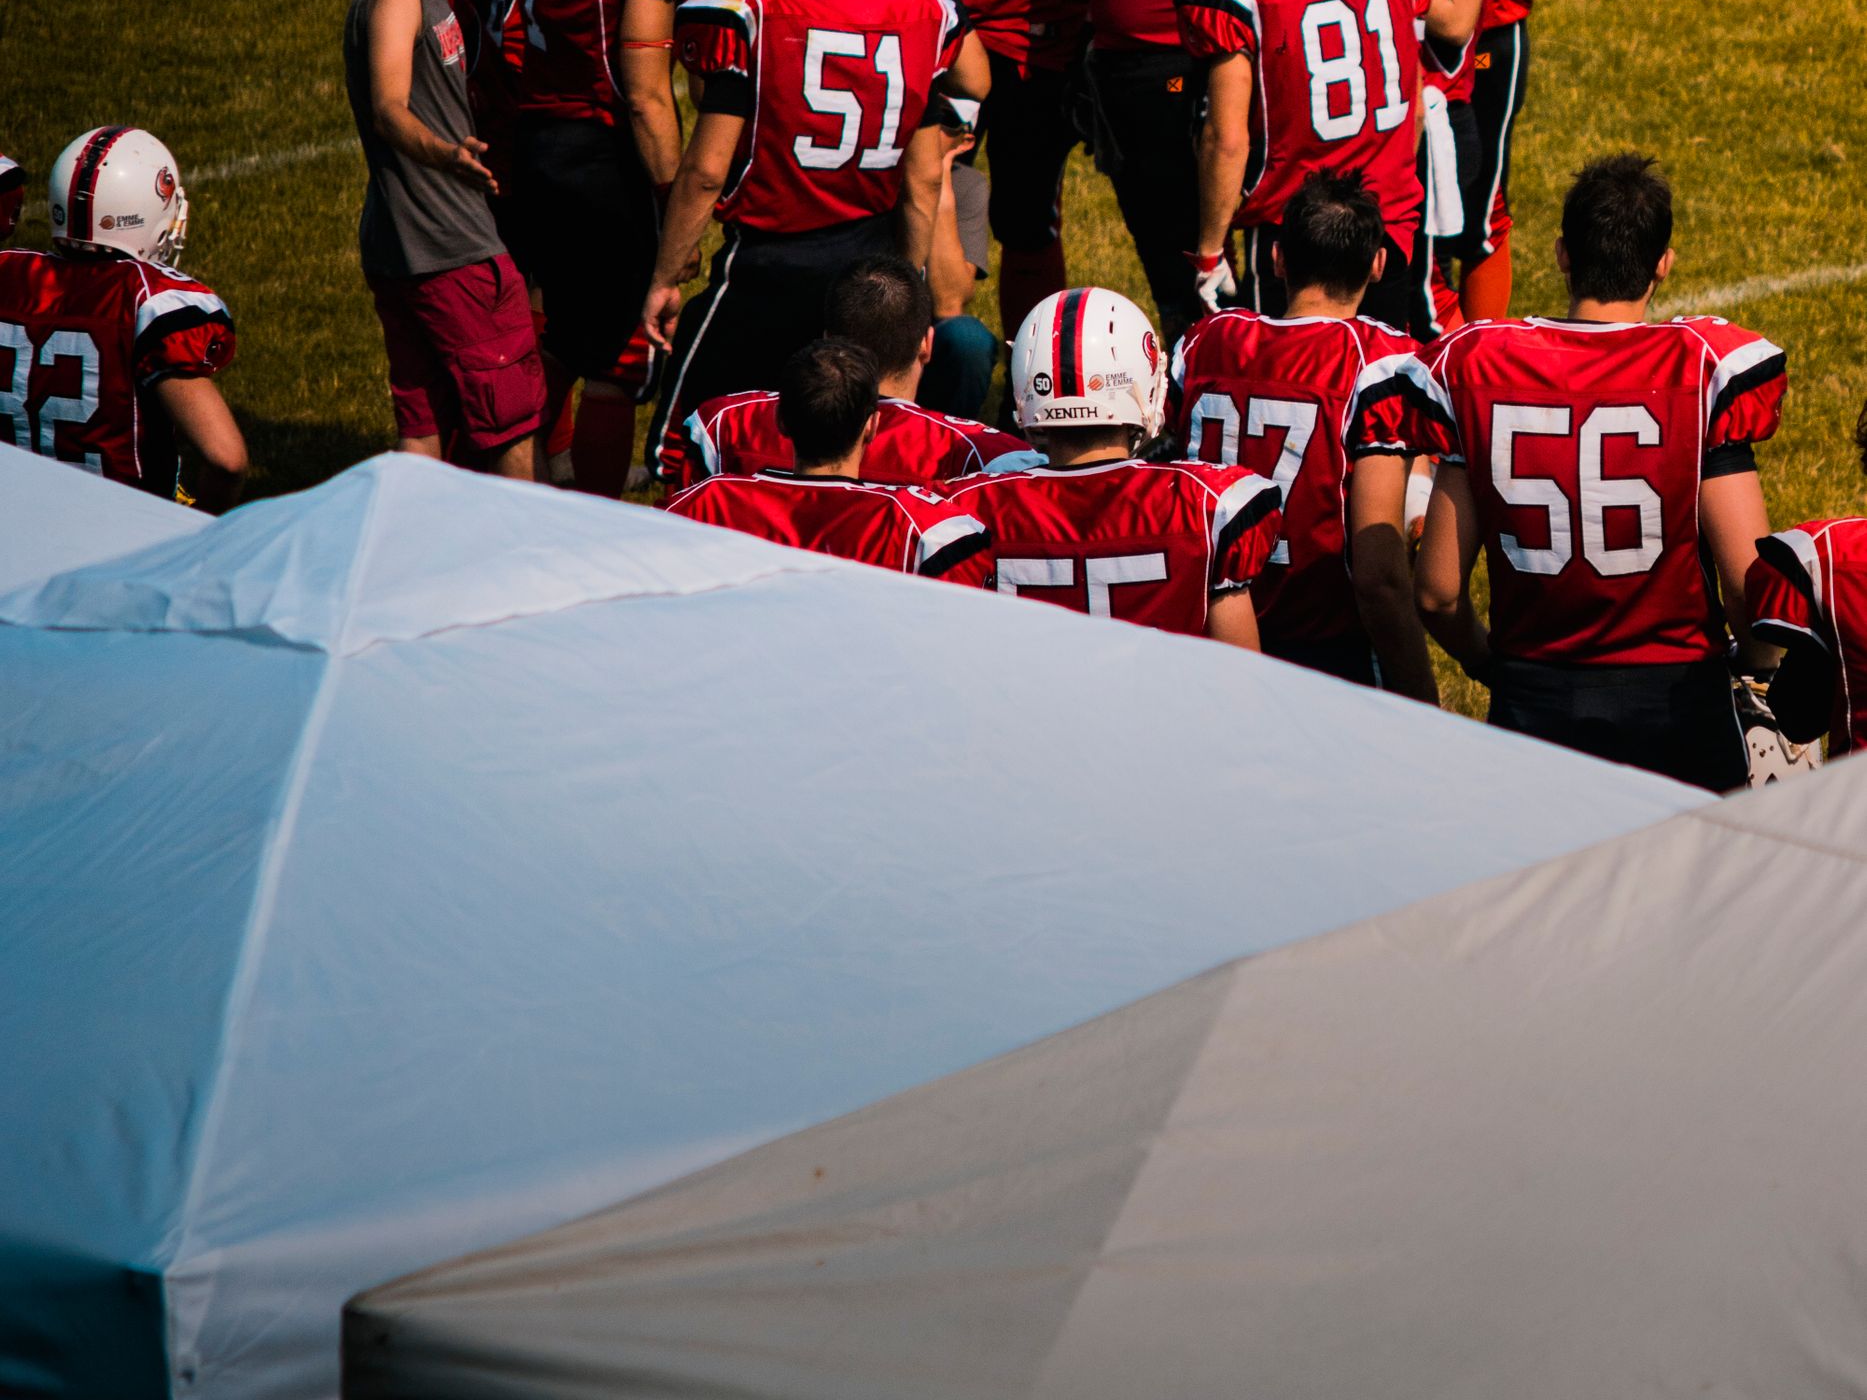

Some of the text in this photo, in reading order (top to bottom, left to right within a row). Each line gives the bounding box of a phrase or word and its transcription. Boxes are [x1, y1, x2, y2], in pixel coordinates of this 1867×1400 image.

[793, 28, 905, 170] 51
[1105, 372, 1127, 380] EMME
[1113, 377, 1134, 386] EMME
[1034, 377, 1051, 392] 50
[1044, 406, 1099, 420] XENITH
[1491, 404, 1664, 576] 56
